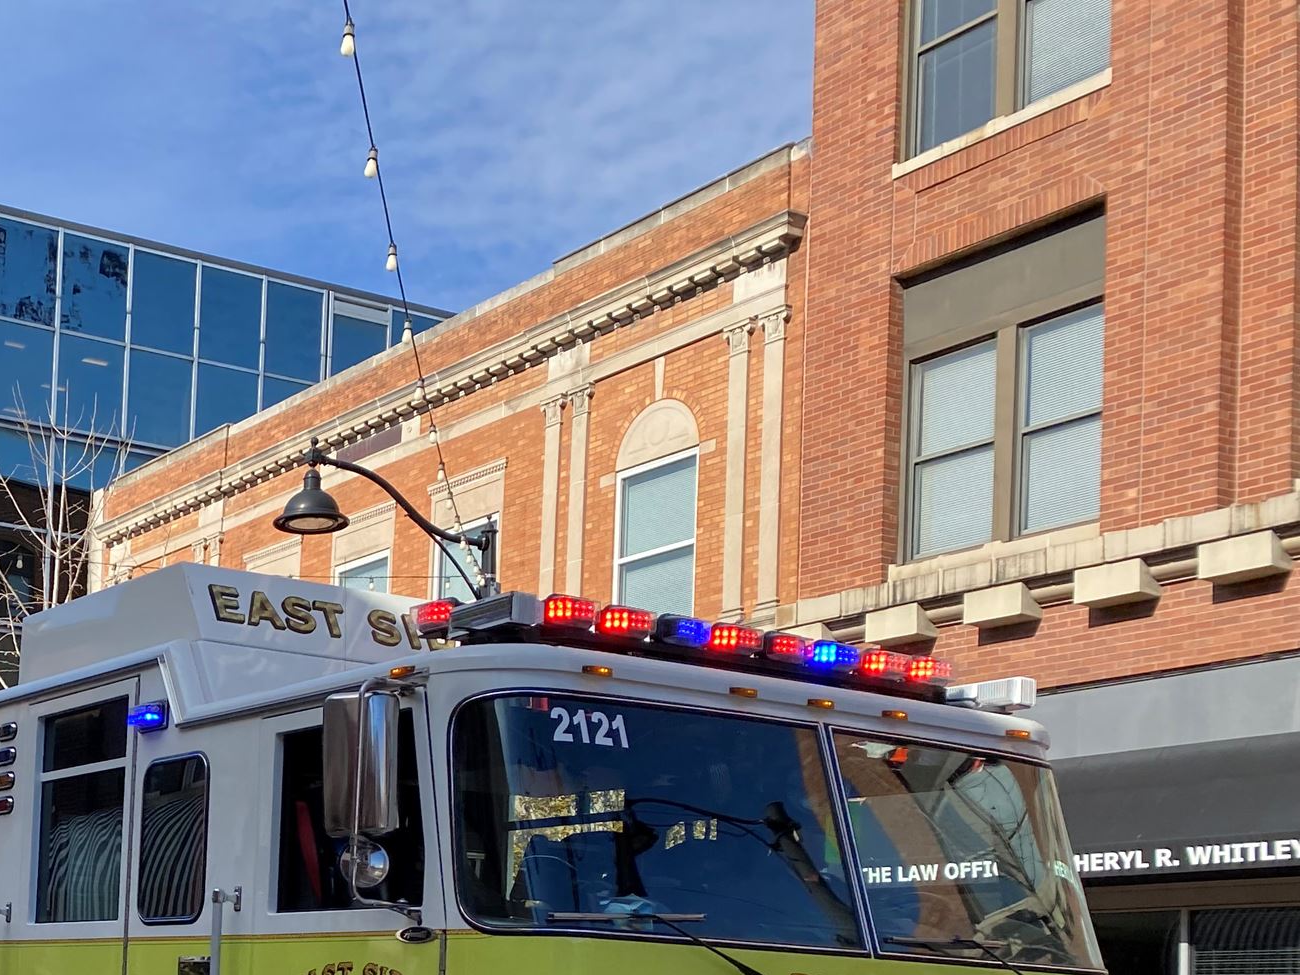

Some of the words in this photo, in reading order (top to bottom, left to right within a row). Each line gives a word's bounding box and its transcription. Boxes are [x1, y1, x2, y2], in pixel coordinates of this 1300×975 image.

[208, 584, 345, 639] EAST
[367, 609, 455, 651] SI
[550, 707, 629, 748] 2121
[897, 863, 939, 882] LAW
[1074, 850, 1150, 872] HERYL
[1155, 848, 1180, 868] R.
